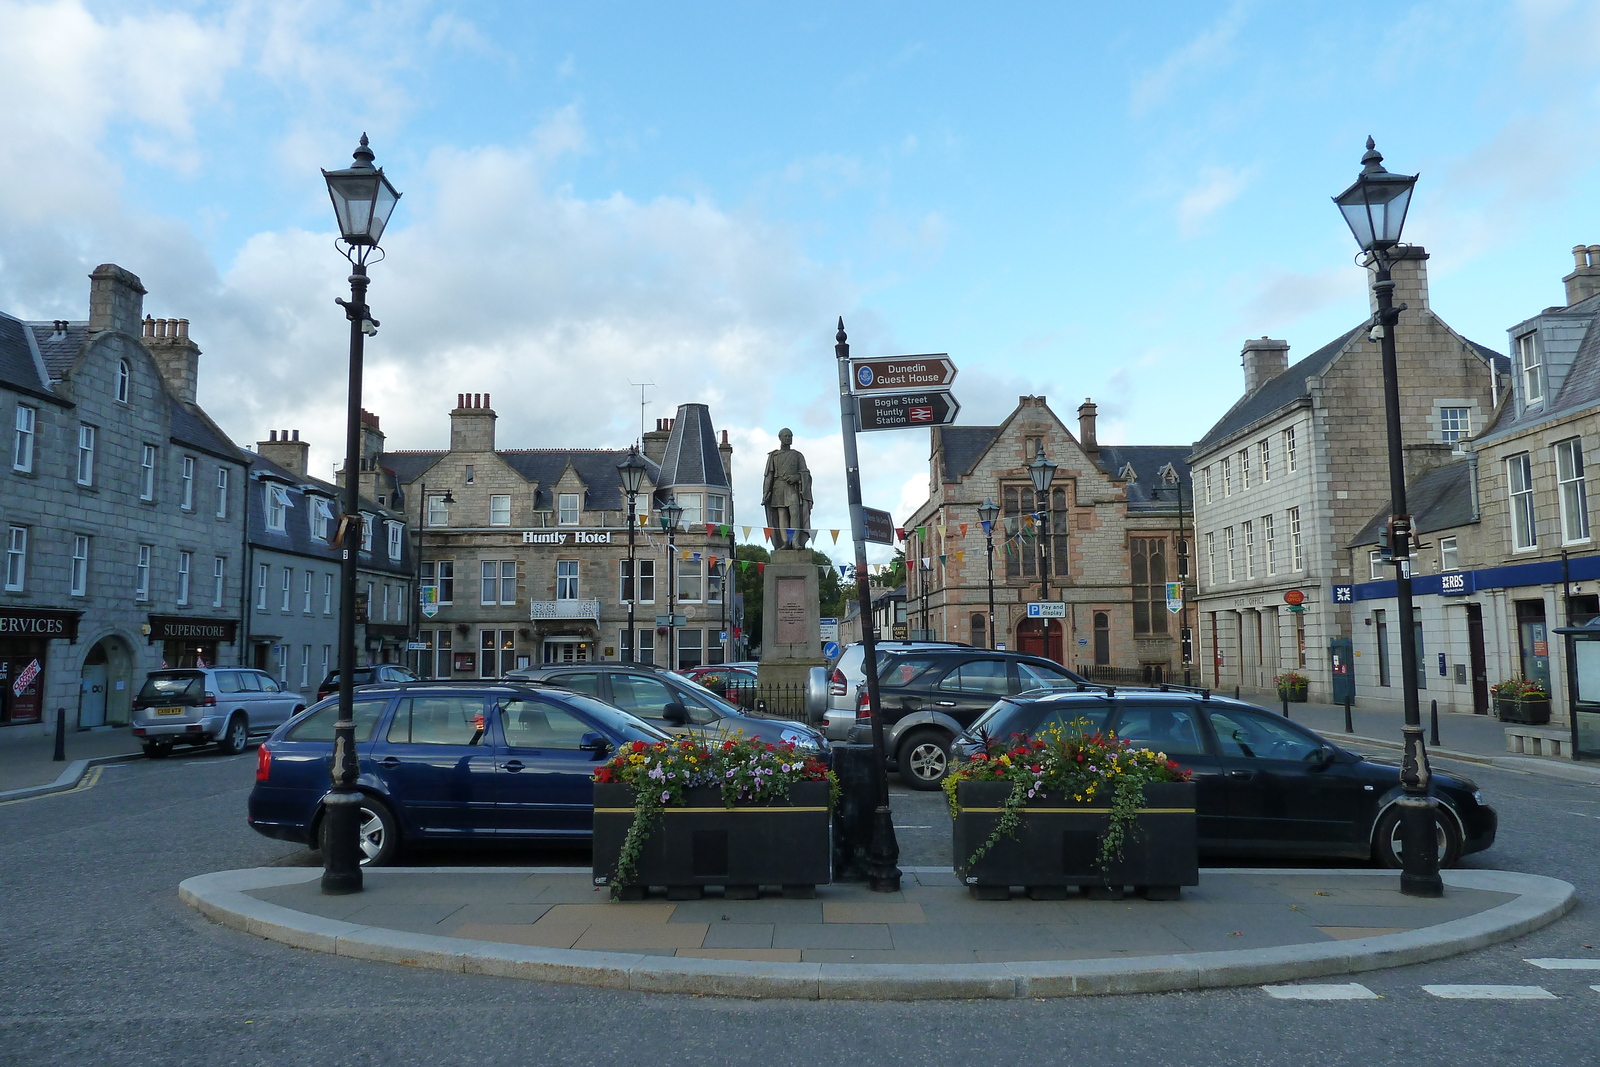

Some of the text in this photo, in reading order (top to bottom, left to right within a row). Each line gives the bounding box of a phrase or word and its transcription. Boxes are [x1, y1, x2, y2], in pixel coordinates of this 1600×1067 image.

[888, 363, 927, 374] Dunedin
[877, 374, 939, 385] Guest House
[874, 396, 928, 407] Bogie Street
[876, 408, 904, 416] Huntly
[876, 416, 906, 425] Station
[522, 531, 611, 545] Huntly Hotel
[1449, 574, 1464, 588] RBS
[1234, 596, 1265, 607] POST OFFICE
[1031, 605, 1039, 615] P
[0, 617, 63, 633] ERVICES
[163, 624, 225, 637] SUPERSTORE
[13, 660, 38, 690] CLOSING
[18, 669, 38, 692] DOWN
